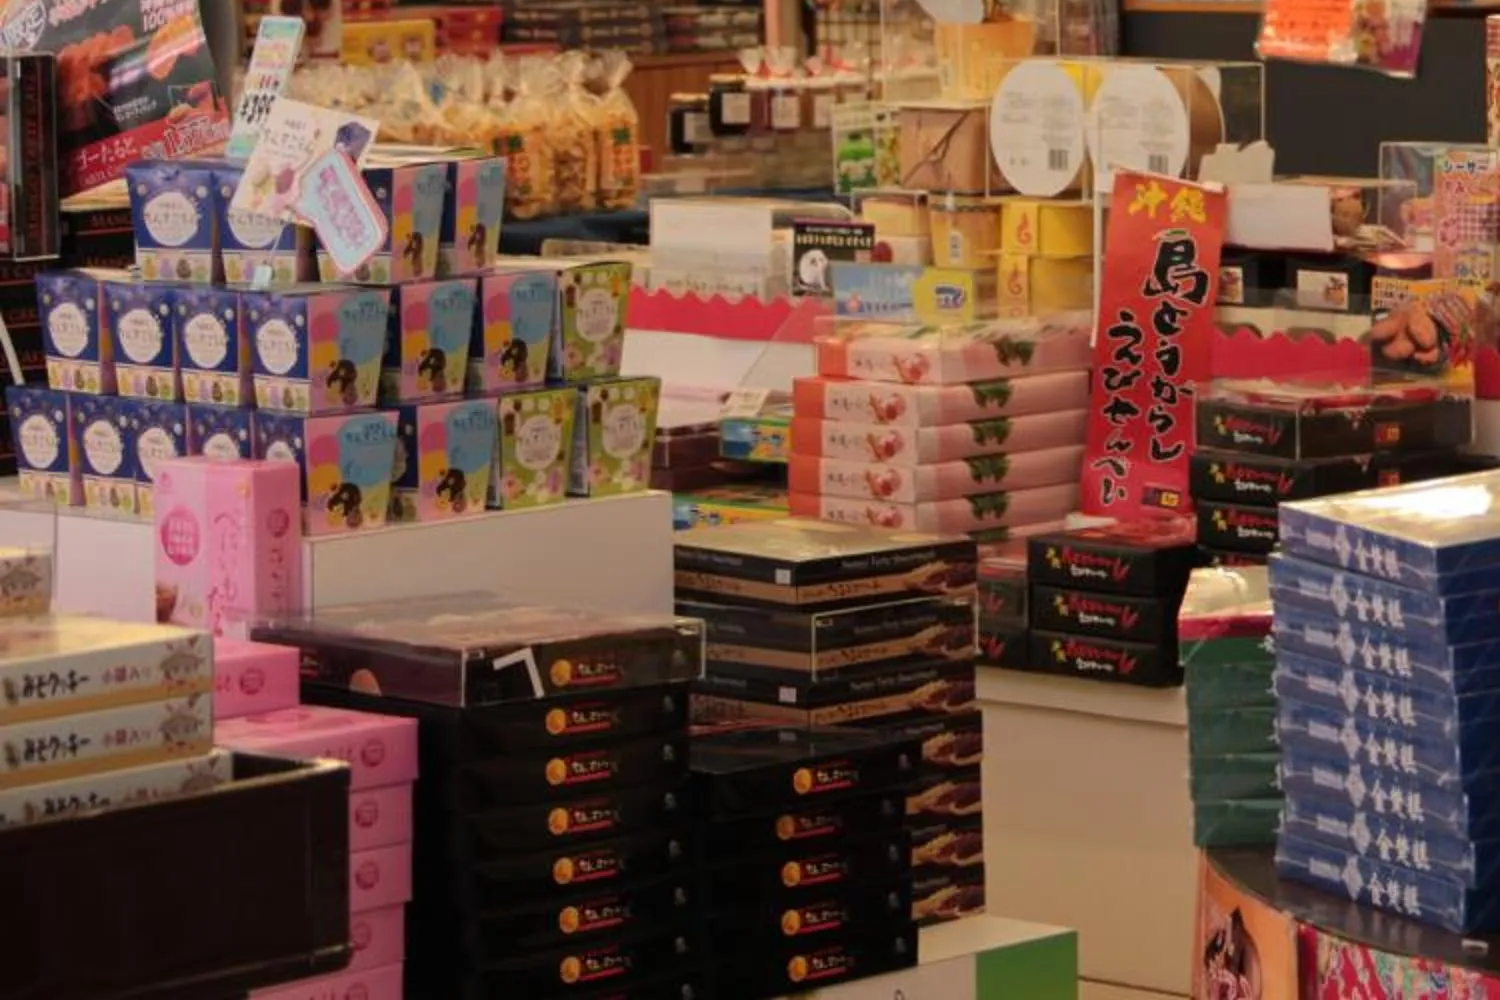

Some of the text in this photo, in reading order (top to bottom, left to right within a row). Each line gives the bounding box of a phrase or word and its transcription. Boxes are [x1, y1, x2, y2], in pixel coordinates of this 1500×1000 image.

[1127, 181, 1208, 224] 沖縄
[1143, 228, 1210, 462] 島とうがらし
[1092, 309, 1145, 506] えびせんべい
[22, 669, 91, 699] みそクッキー
[23, 732, 92, 763] みそクッキー
